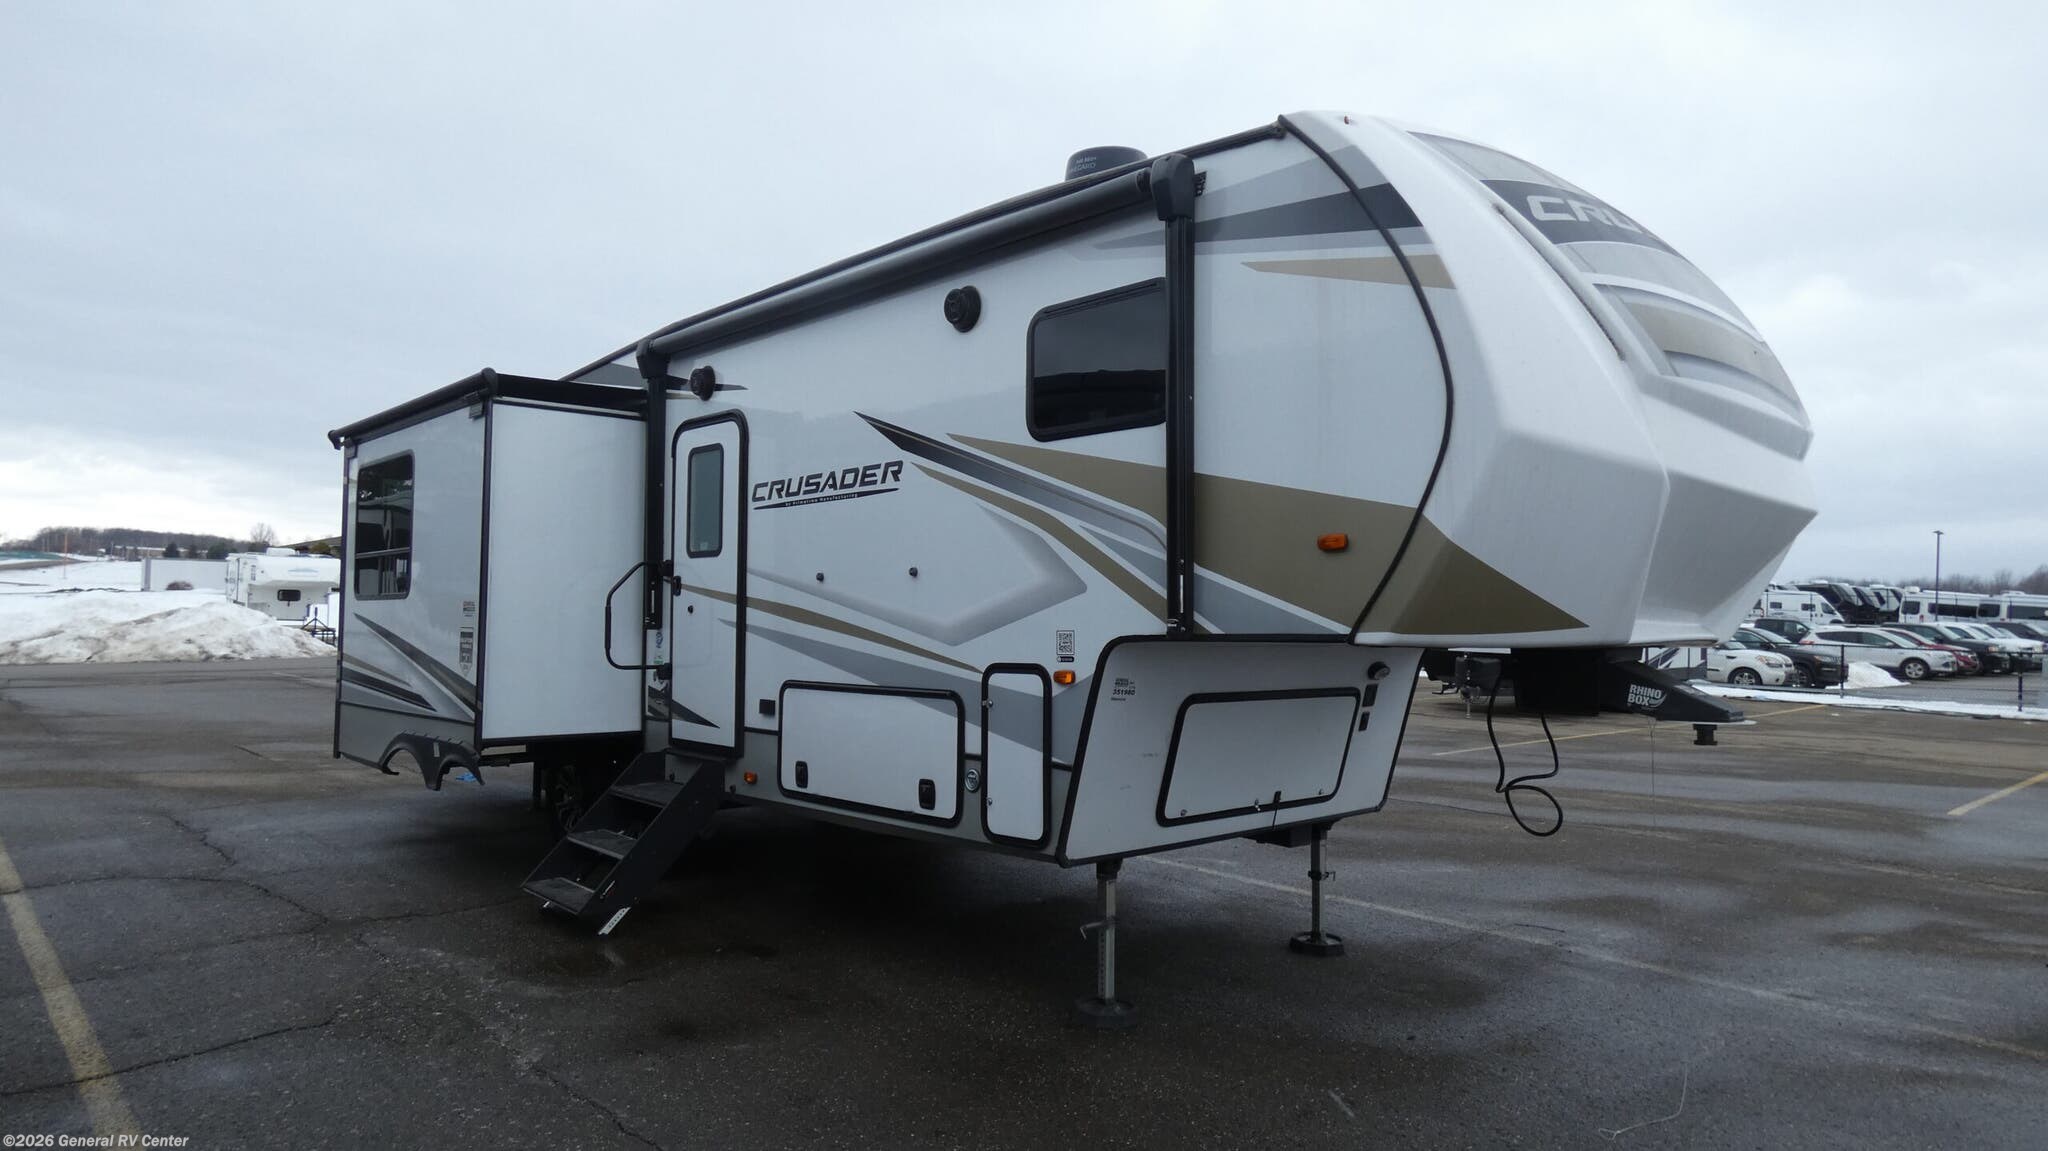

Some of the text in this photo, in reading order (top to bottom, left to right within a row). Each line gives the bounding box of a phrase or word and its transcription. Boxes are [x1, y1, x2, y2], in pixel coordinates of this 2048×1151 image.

[1526, 195, 1644, 233] CRU
[751, 460, 904, 502] CRUSADER
[1627, 693, 1650, 706] BOX
[1629, 684, 1662, 699] RHINO
